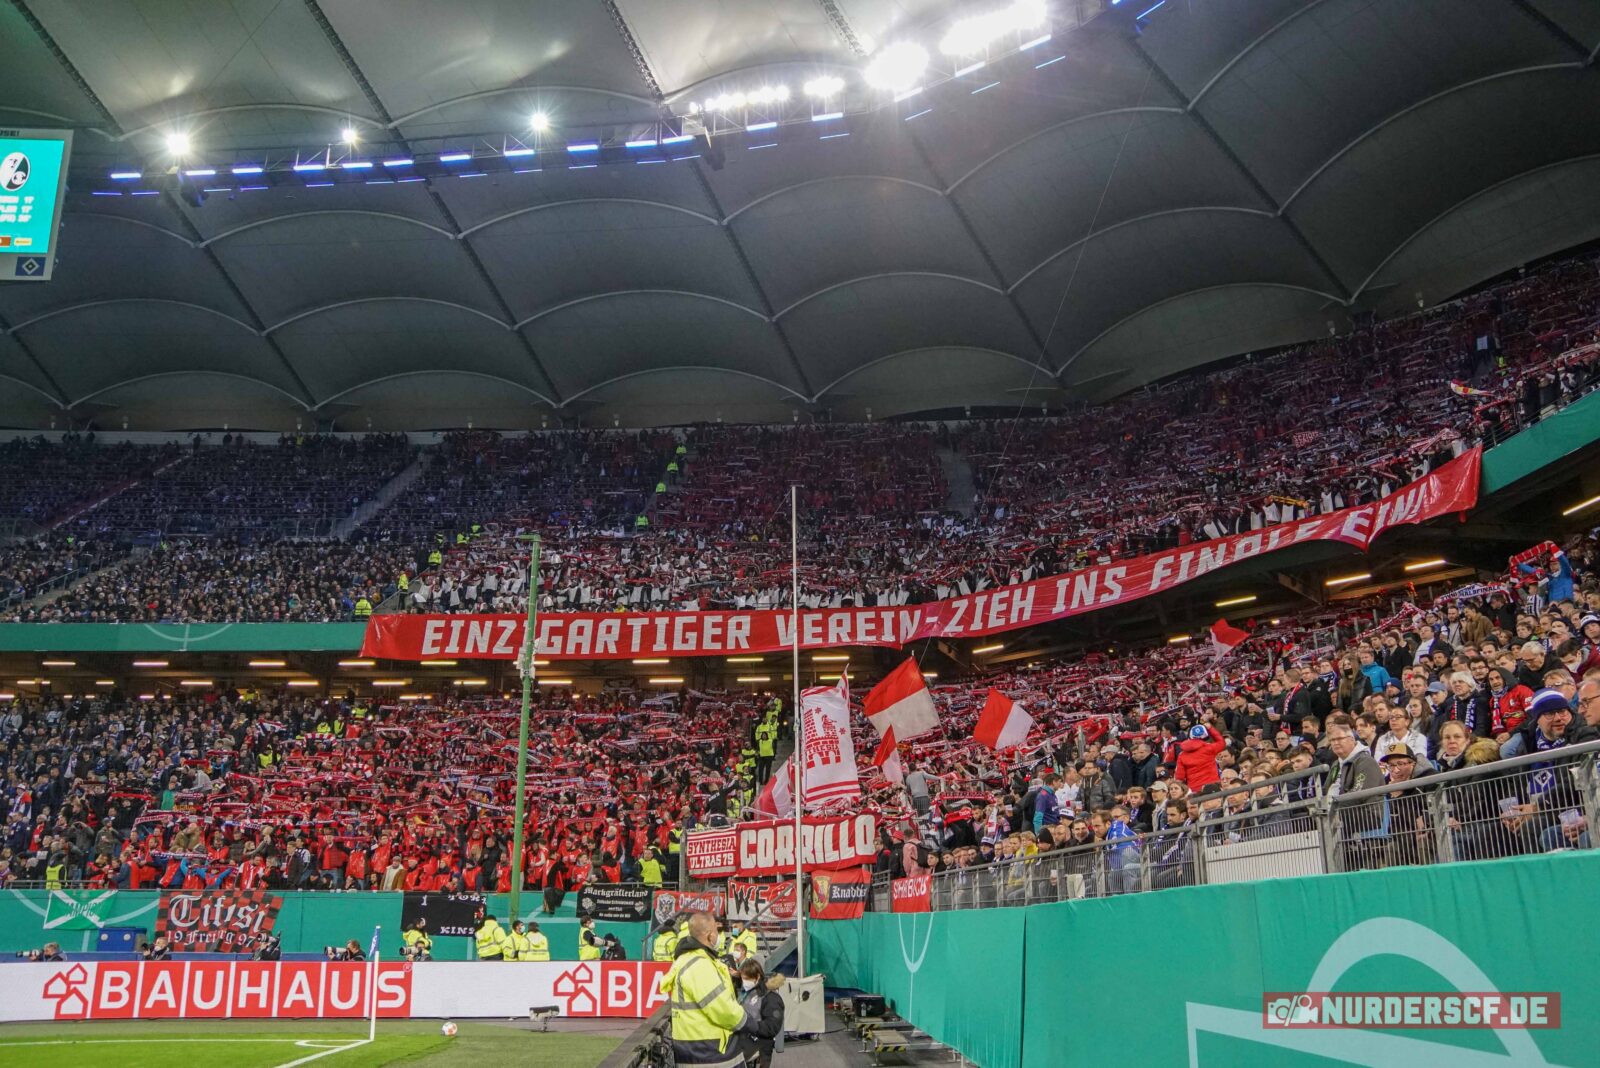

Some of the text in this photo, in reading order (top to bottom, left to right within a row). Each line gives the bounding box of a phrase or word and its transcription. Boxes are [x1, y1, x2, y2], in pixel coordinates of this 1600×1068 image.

[421, 615, 751, 655] EINZIGARTIGER
[1052, 567, 1127, 614] INS
[1341, 483, 1427, 543] EIN!
[687, 837, 736, 855] SYNTHESIA
[690, 853, 734, 869] ULTRAS 79
[740, 814, 876, 870] CORRILLO
[99, 969, 406, 1010] BAUHAUS
